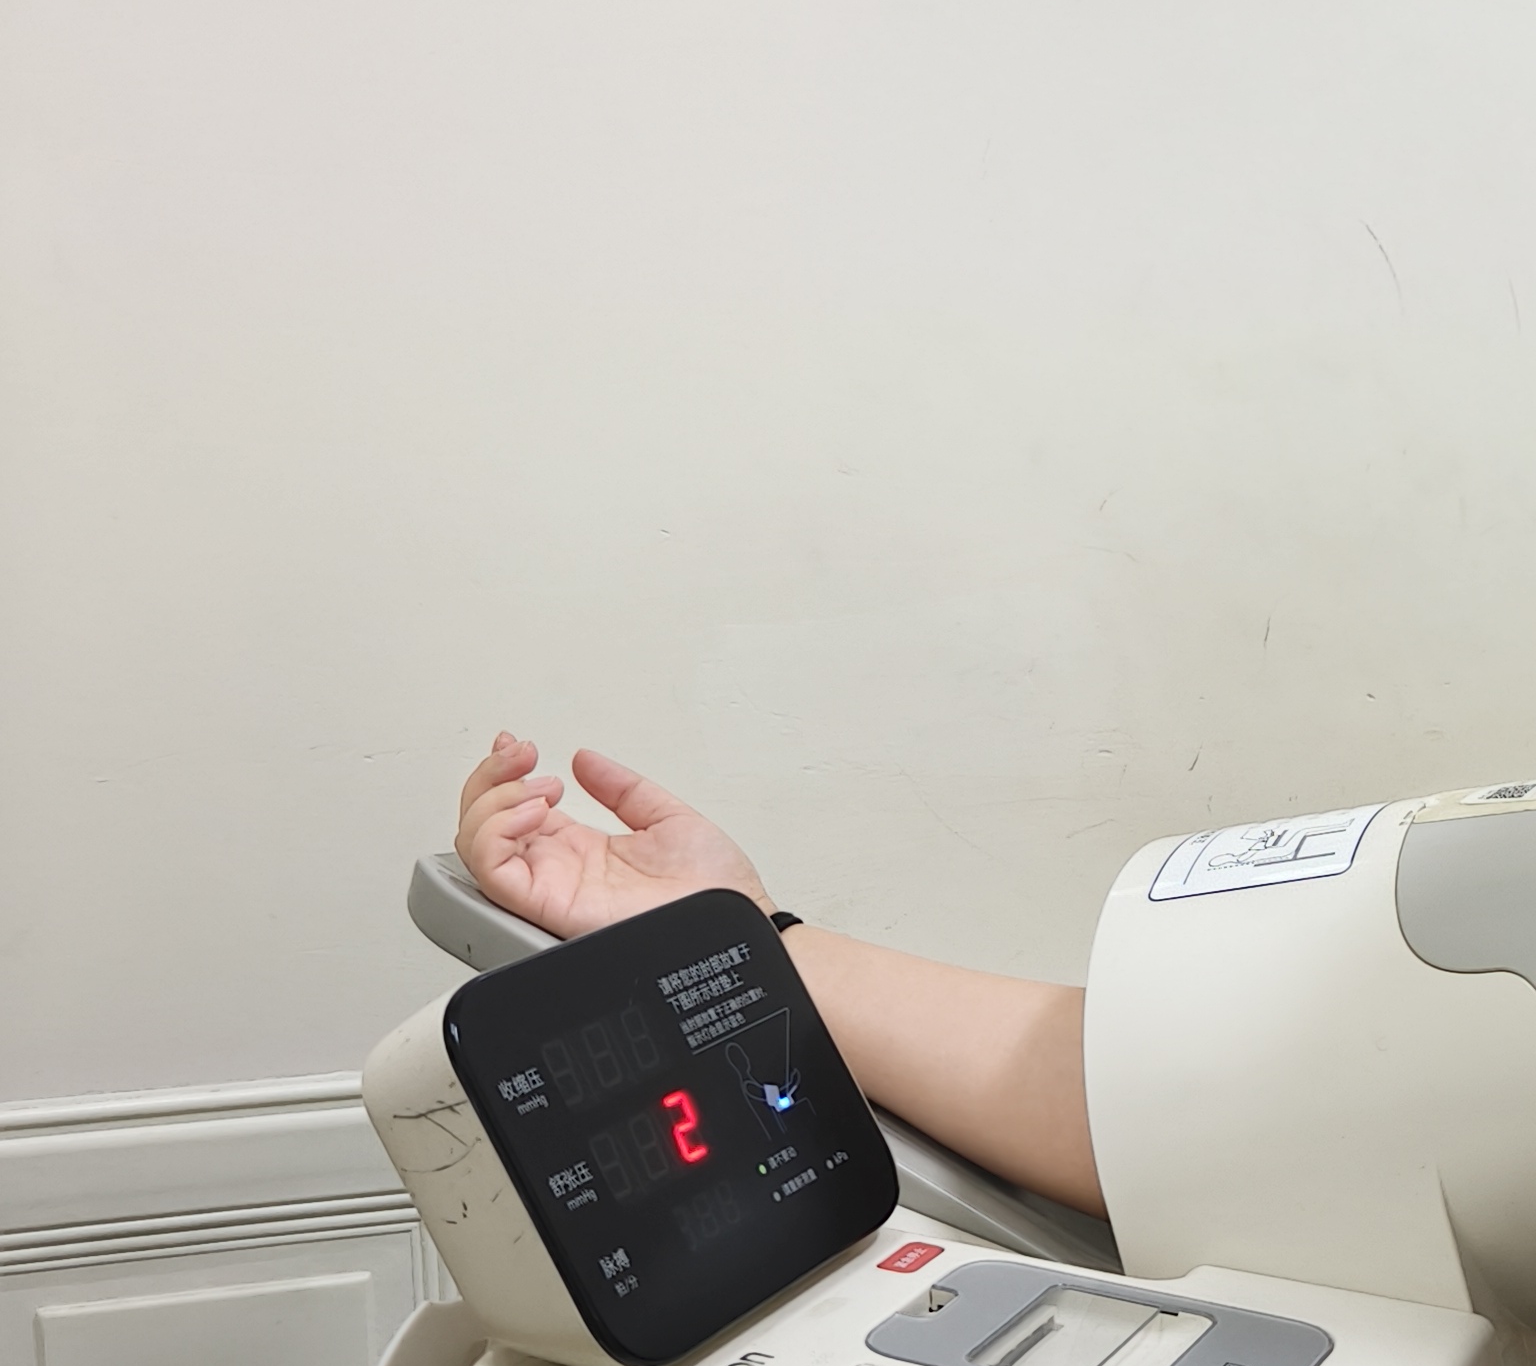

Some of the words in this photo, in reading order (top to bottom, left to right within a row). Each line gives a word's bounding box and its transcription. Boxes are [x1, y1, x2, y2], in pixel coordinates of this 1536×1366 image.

[498, 1067, 546, 1102] 收缩压
[517, 1093, 549, 1116] mmHg
[662, 1089, 709, 1164] 2
[549, 1160, 594, 1198] 舒张压
[567, 1187, 598, 1211] mmHg
